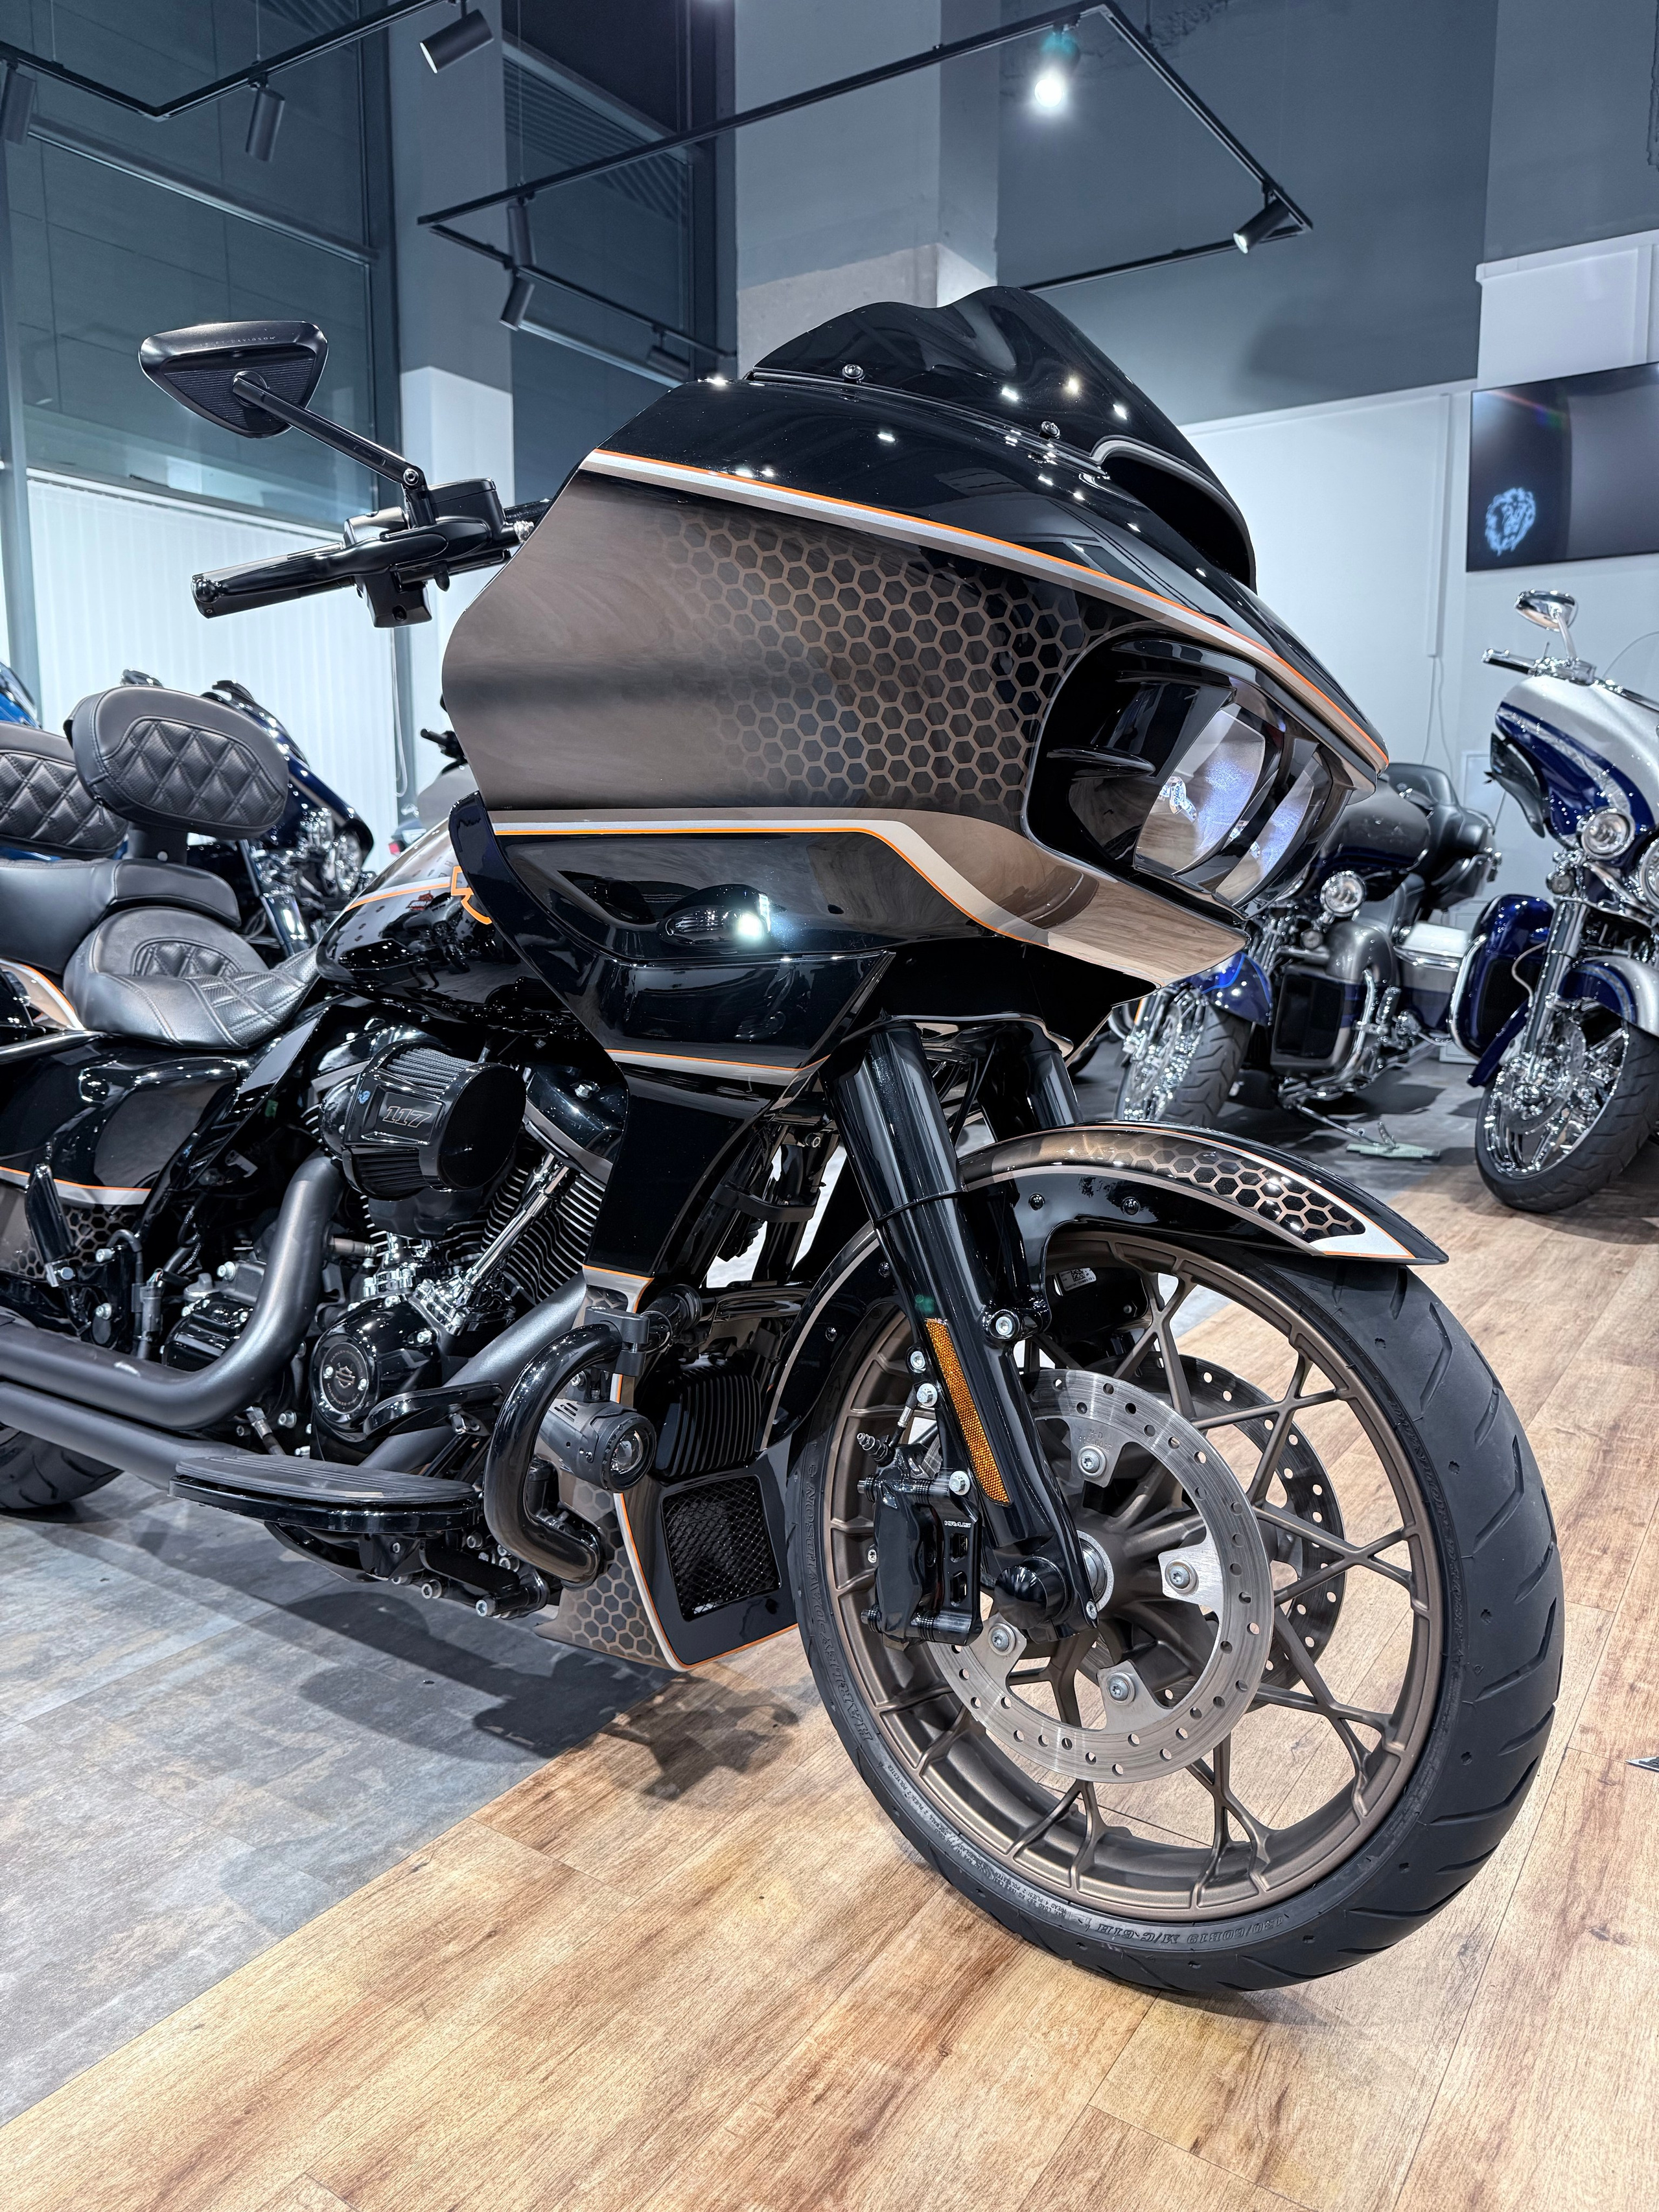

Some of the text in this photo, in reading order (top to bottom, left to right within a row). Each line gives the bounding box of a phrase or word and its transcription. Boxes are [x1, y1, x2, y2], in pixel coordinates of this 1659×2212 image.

[382, 1105, 432, 1128] 117
[802, 1481, 874, 1744] HARLEY-DAVIDSON
[1094, 1913, 1286, 1945] 130/60B19 M/C 61H
